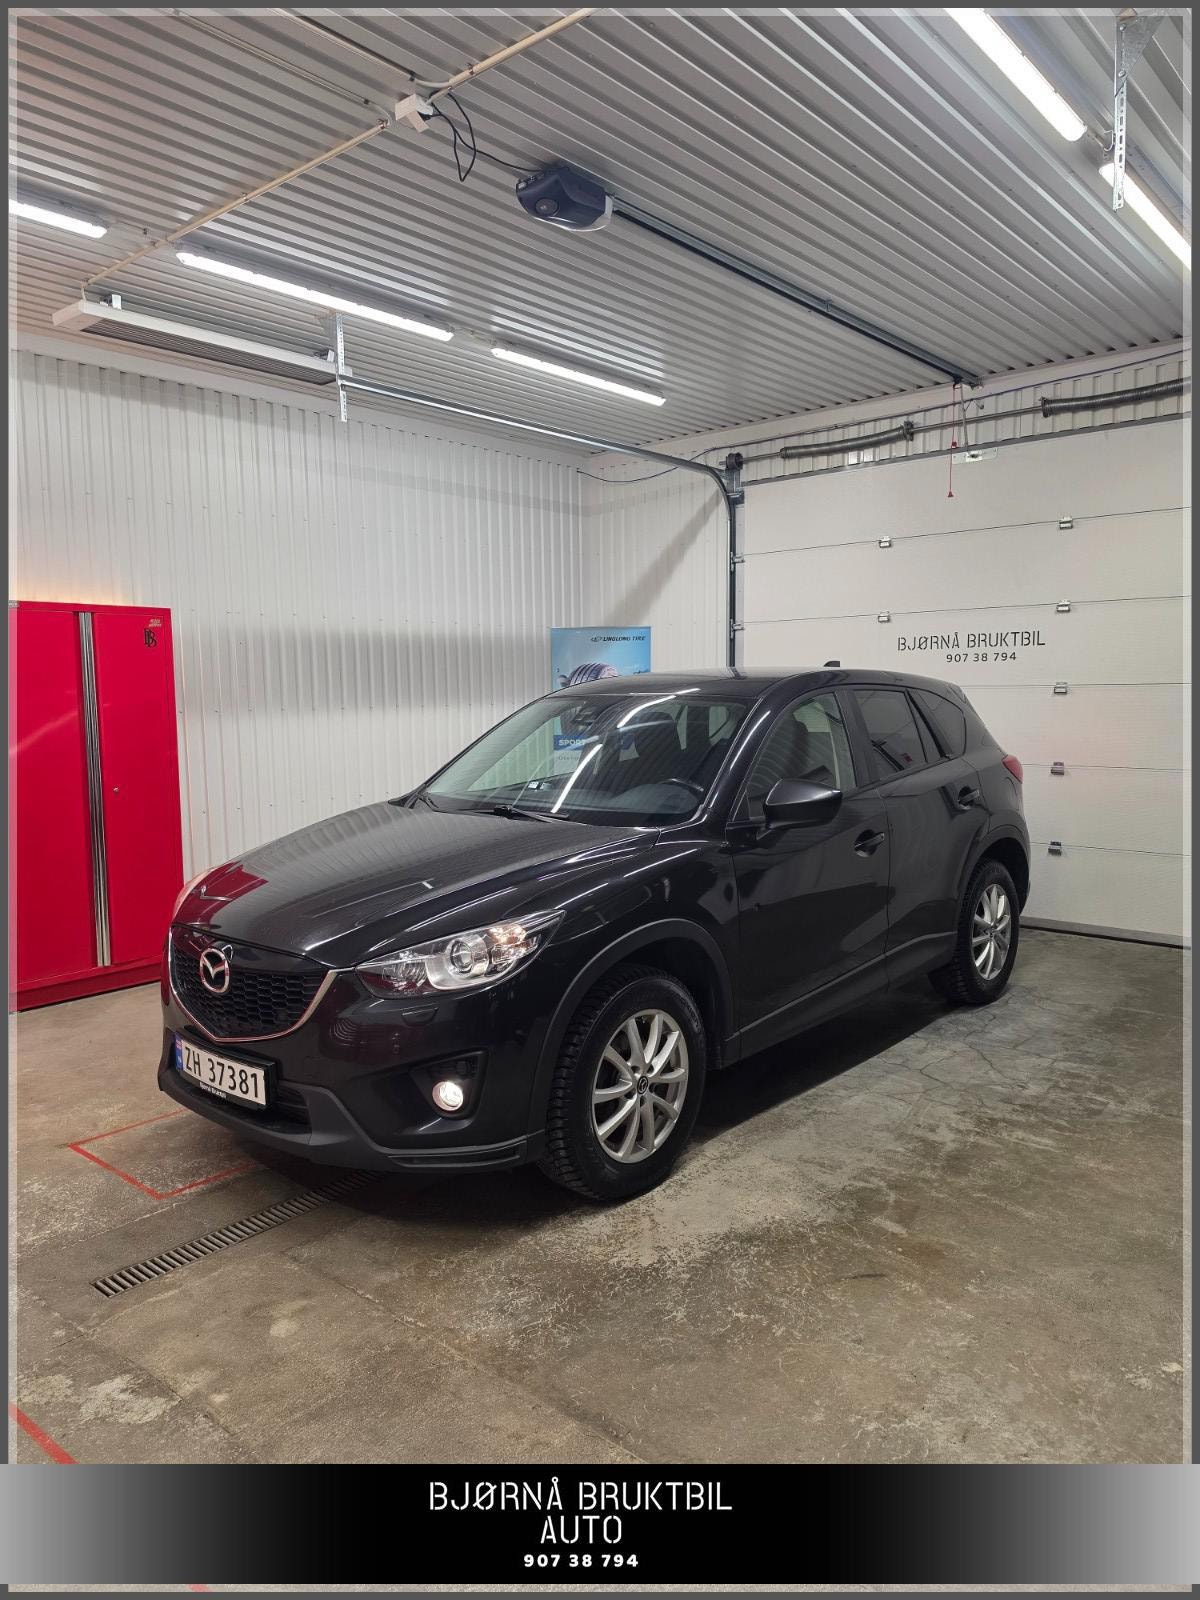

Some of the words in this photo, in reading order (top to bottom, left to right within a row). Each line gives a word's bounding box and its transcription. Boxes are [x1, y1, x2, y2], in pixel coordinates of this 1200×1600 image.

[897, 632, 960, 651] BJØRNÅ
[967, 631, 1045, 648] BRUKTBIL
[946, 653, 969, 663] 907
[973, 653, 988, 662] 38
[993, 652, 1017, 662] 794
[185, 1046, 201, 1077] ZH
[208, 1058, 259, 1098] 37381
